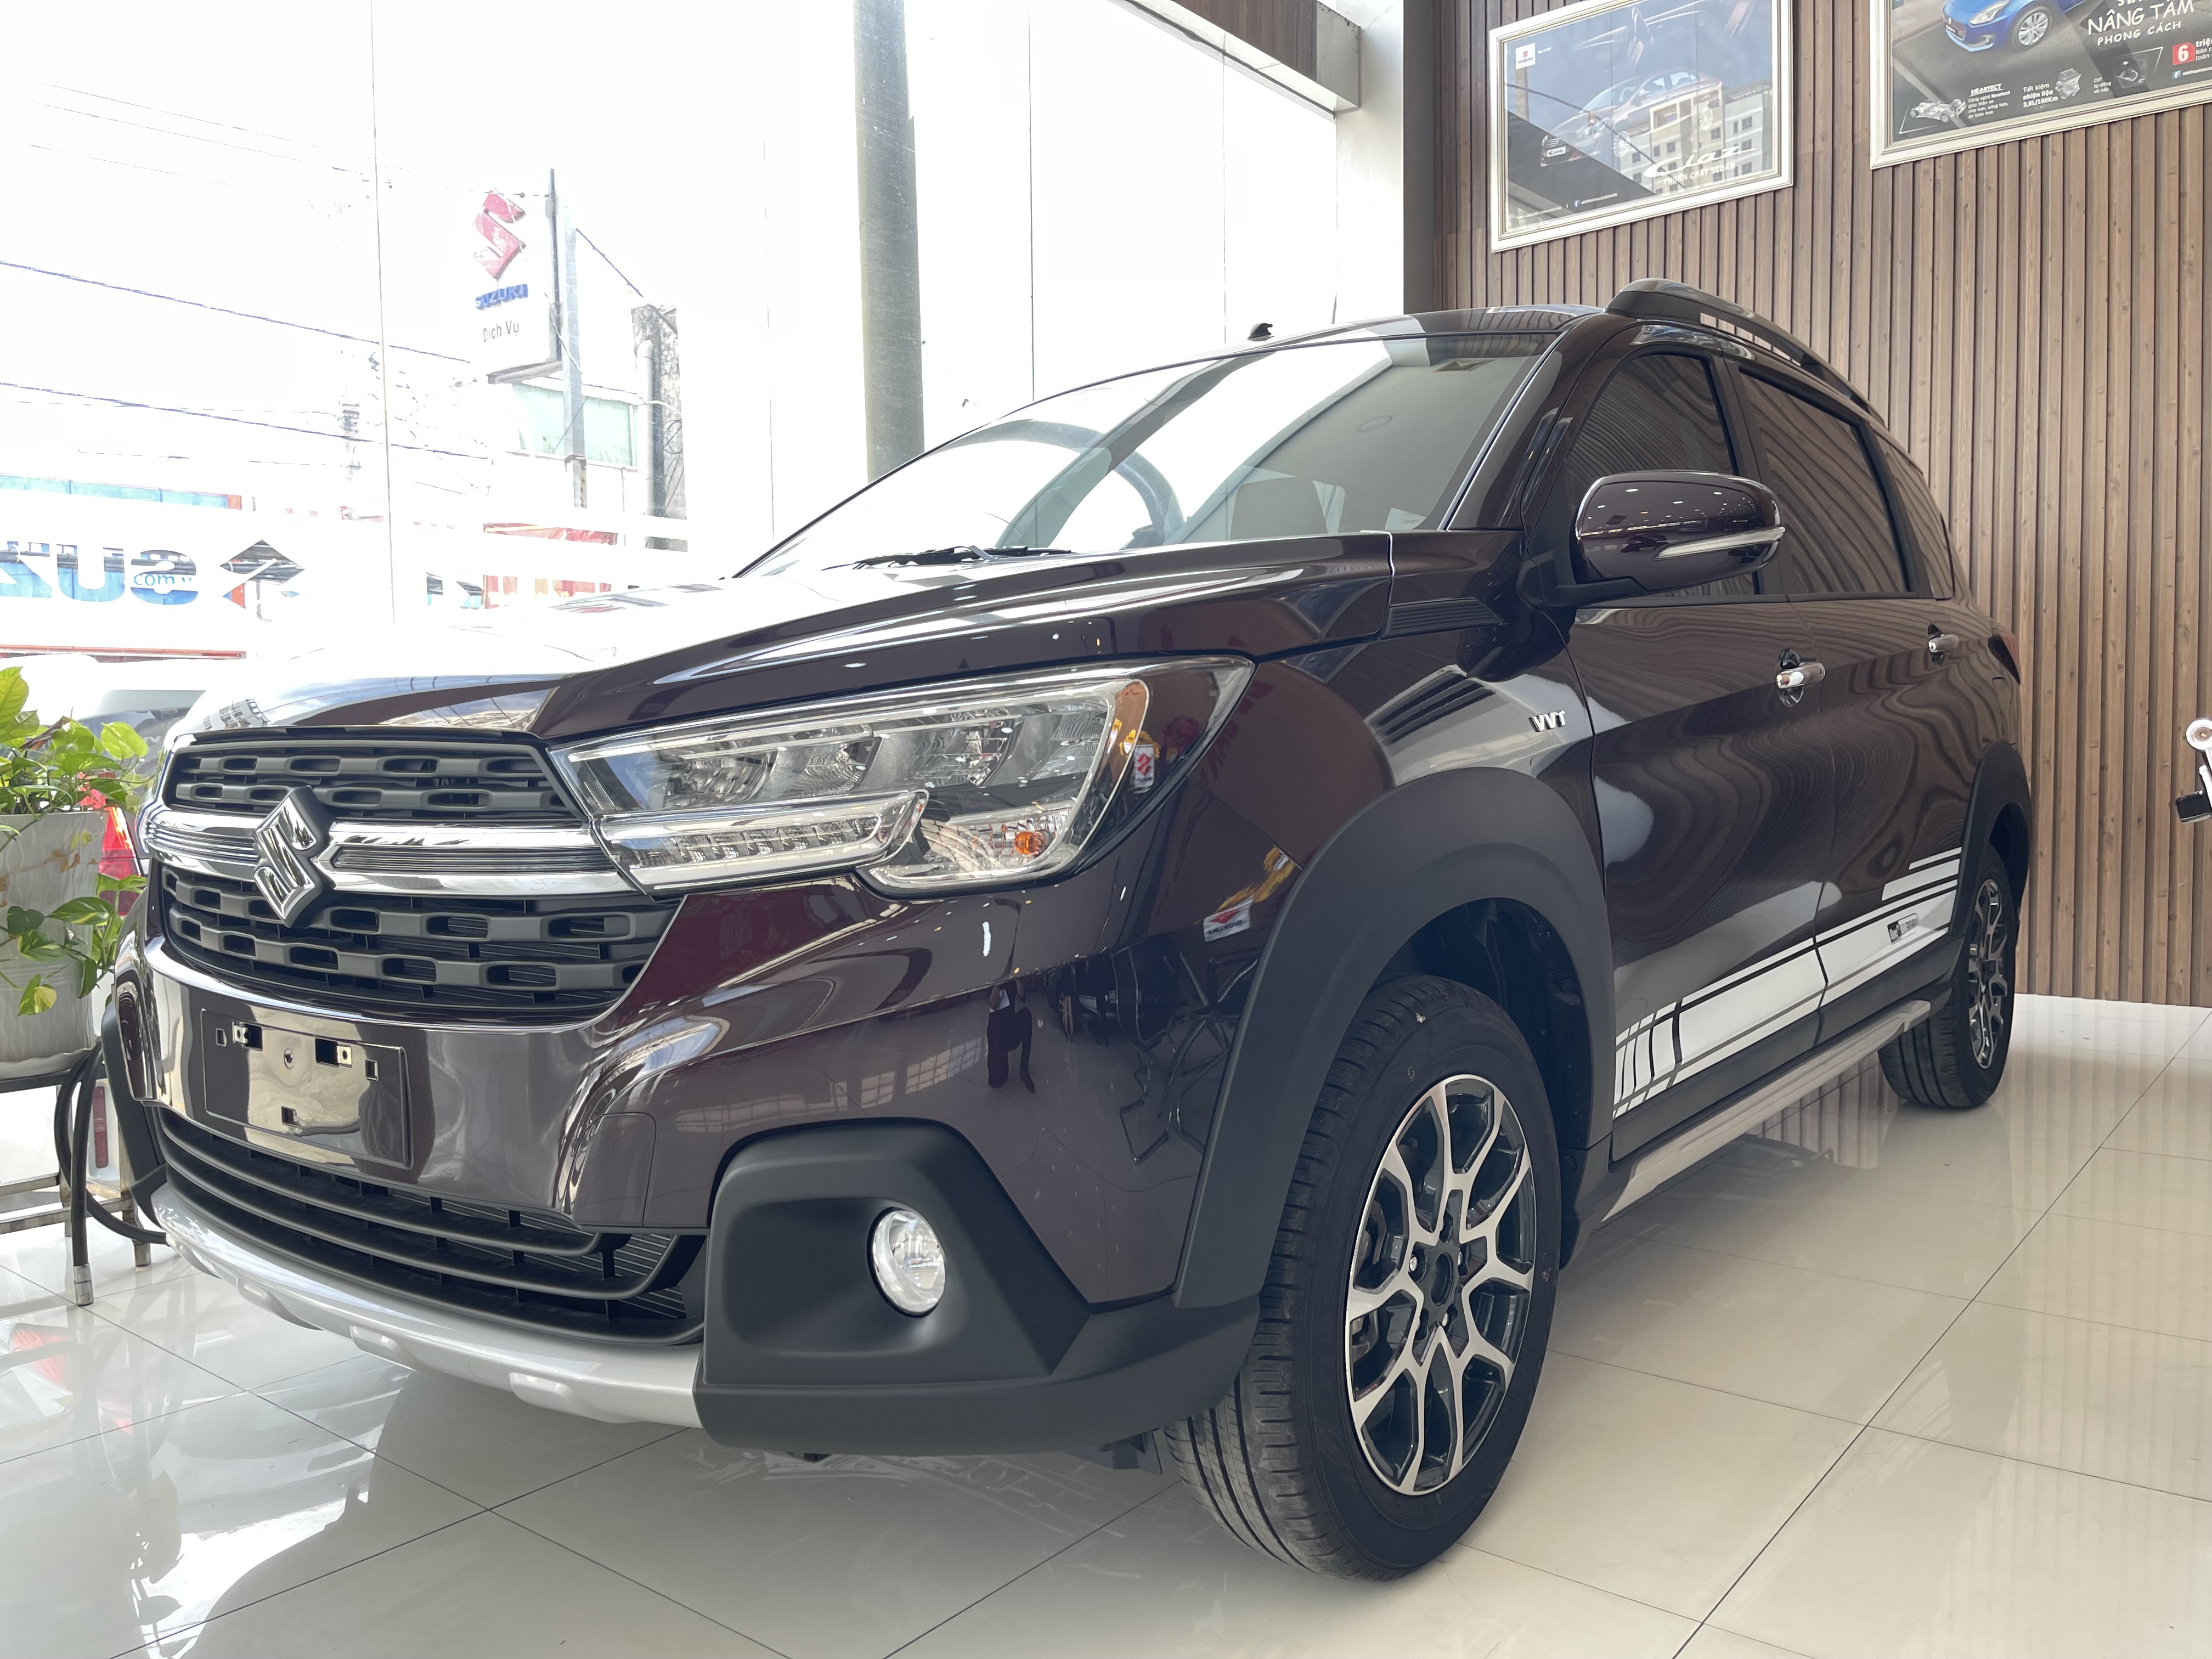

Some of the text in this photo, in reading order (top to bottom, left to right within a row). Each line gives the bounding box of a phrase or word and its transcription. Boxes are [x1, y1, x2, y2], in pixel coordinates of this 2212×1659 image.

[2088, 8, 2145, 35] NÂNG
[2097, 20, 2181, 46] PHONG CÁCH
[2178, 45, 2189, 62] 6
[1971, 83, 2002, 95] HEARTECT
[1711, 162, 1735, 174] SEDAN
[475, 284, 529, 311] SUZUKI
[505, 320, 520, 336] Vụ
[1528, 710, 1566, 733] VVT
